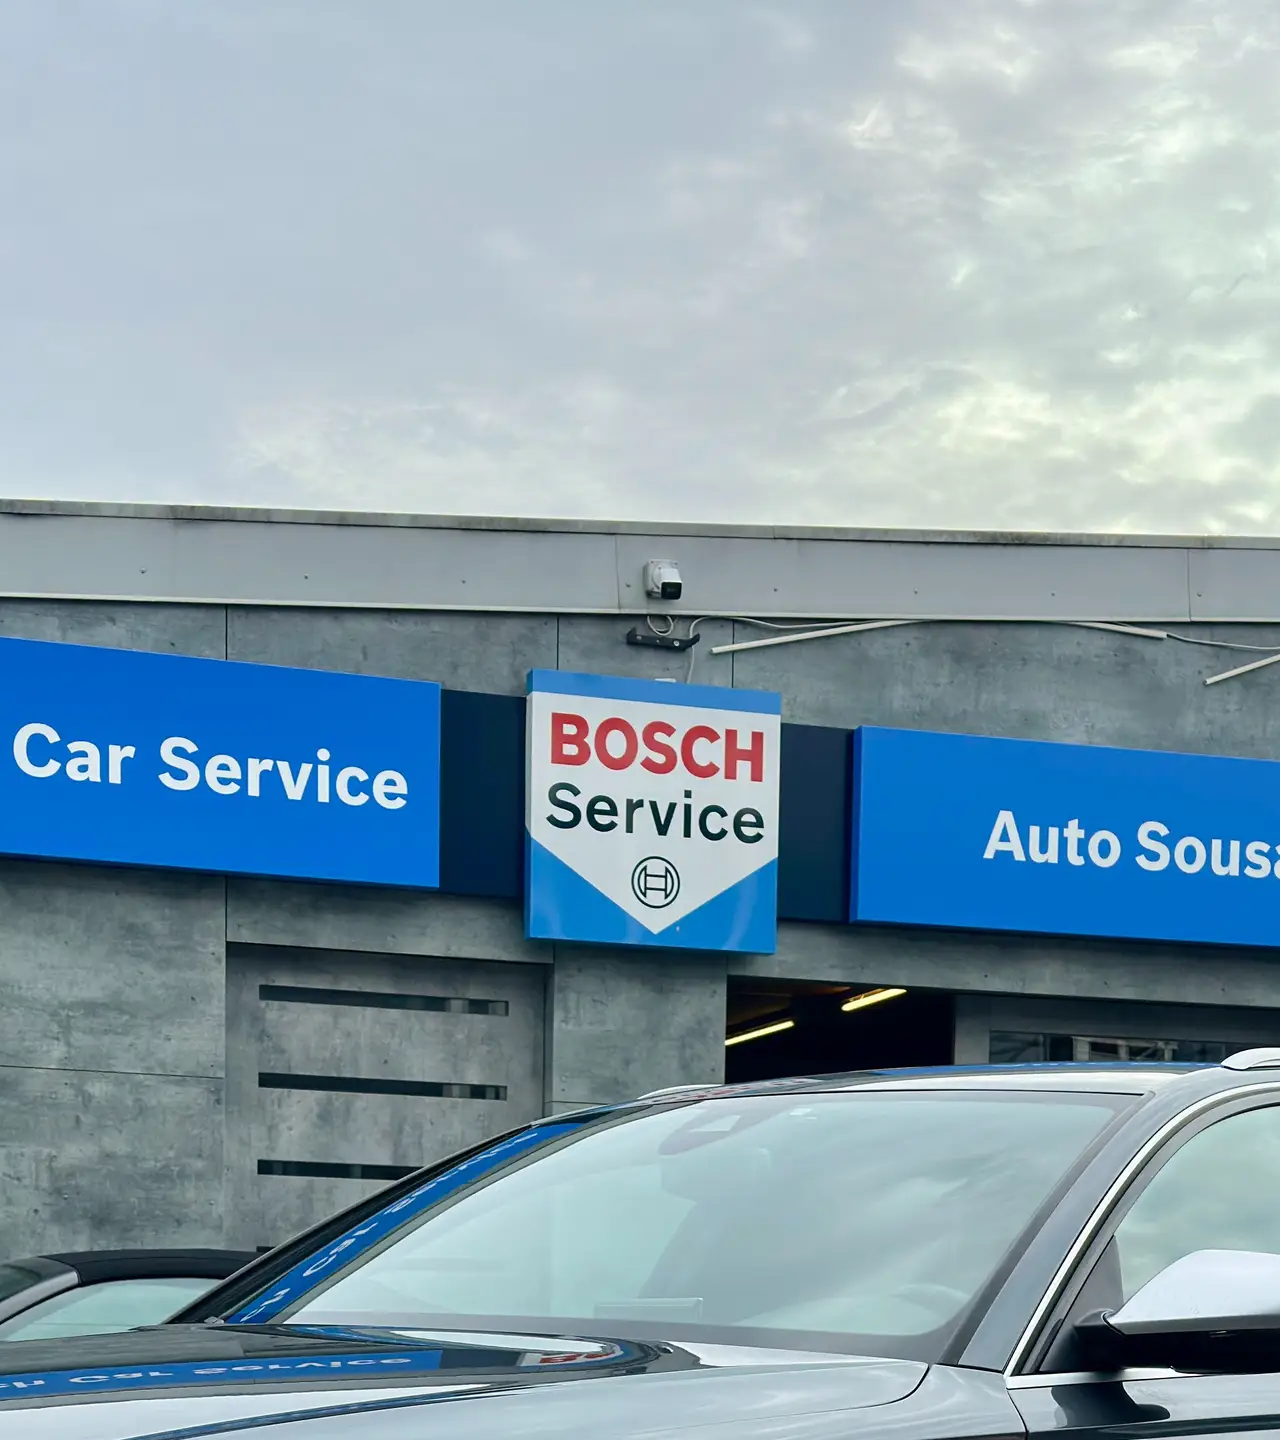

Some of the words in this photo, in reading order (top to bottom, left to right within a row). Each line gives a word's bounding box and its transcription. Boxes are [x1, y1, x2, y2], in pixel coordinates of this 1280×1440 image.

[13, 722, 137, 786] Car
[158, 736, 409, 810] Service
[549, 711, 765, 783] BOSCH
[546, 782, 765, 845] Service
[982, 809, 1121, 869] Auto
